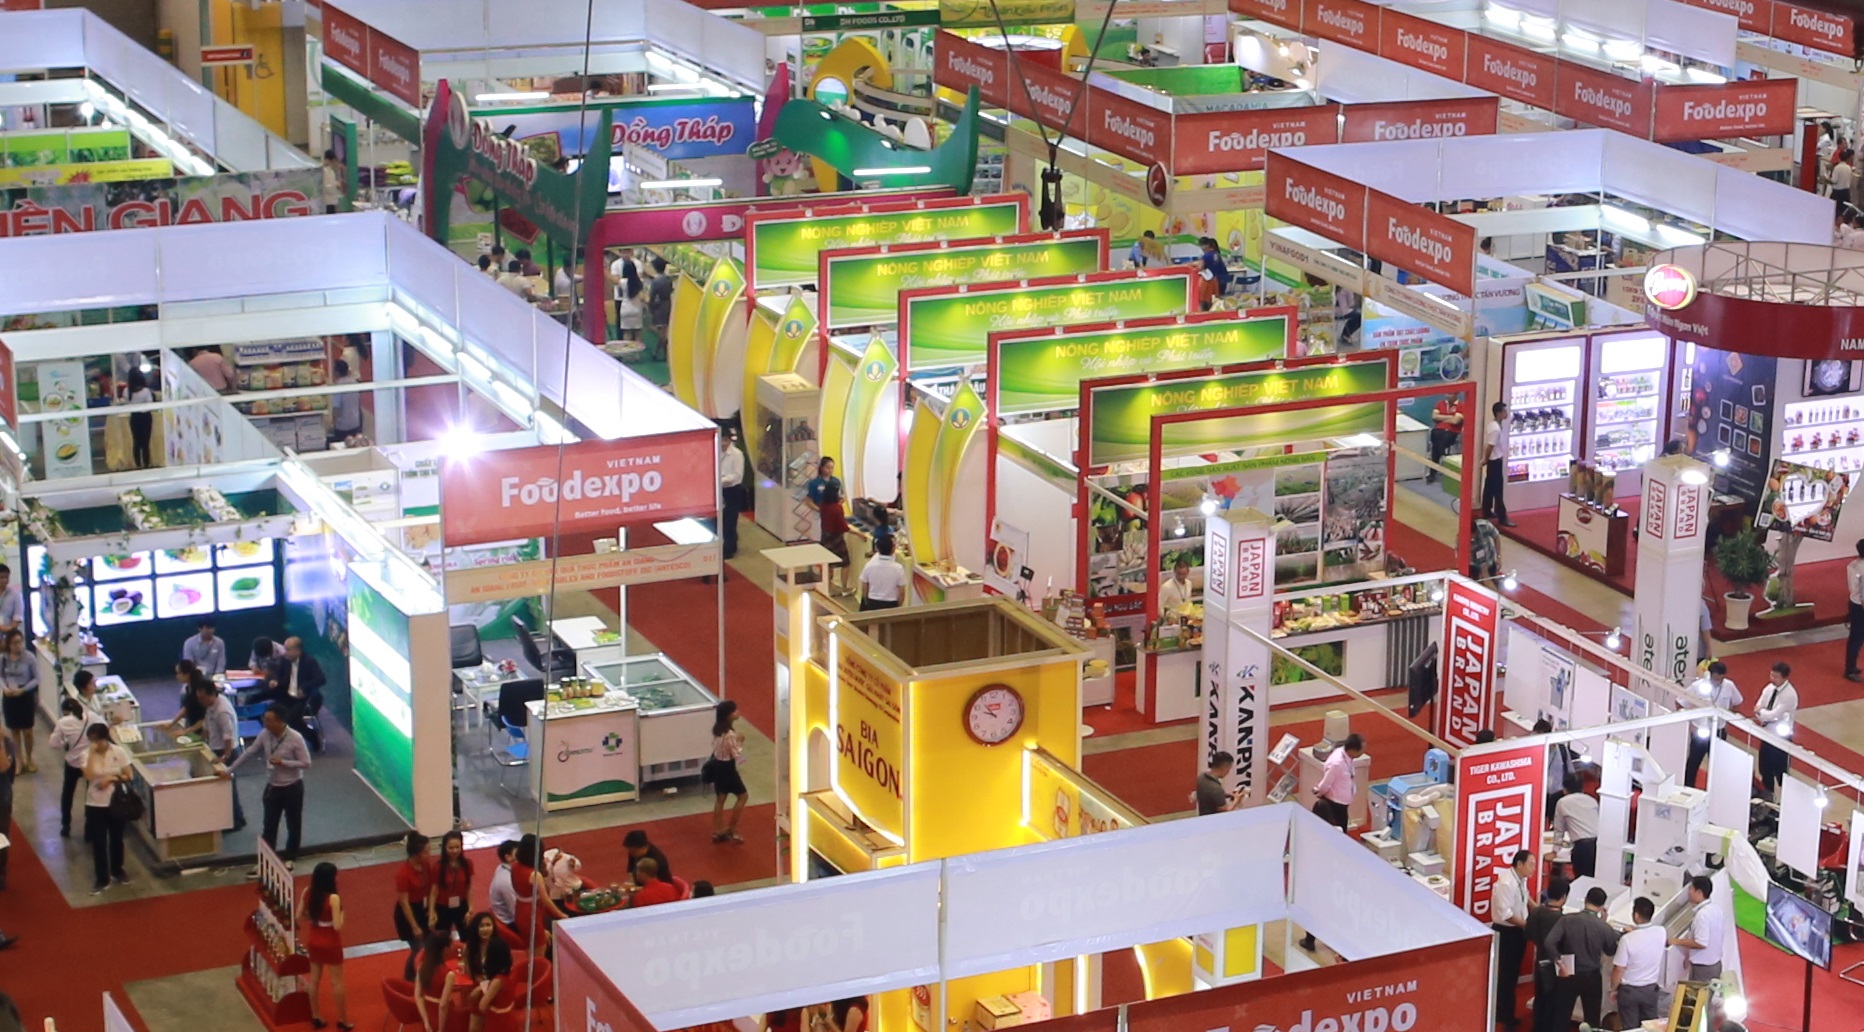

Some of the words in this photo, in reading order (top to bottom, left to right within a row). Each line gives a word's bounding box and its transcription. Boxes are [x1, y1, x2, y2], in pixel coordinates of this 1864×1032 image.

[676, 114, 735, 146] Tháp
[1683, 99, 1768, 123] Foodexpo
[1208, 129, 1306, 153] Foodexpo
[0, 201, 95, 238] IỀN
[107, 190, 310, 231] GIANG
[606, 455, 662, 469] VIETNAM
[501, 469, 663, 508] Foodexpo
[1249, 543, 1263, 593] JAPAN
[1450, 635, 1468, 730] BRAND
[1460, 634, 1483, 743] JAPAN
[860, 720, 879, 749] BIA
[836, 723, 901, 799] SAIGON
[1473, 810, 1495, 916] BRAND
[1345, 979, 1418, 1004] VIETNAM
